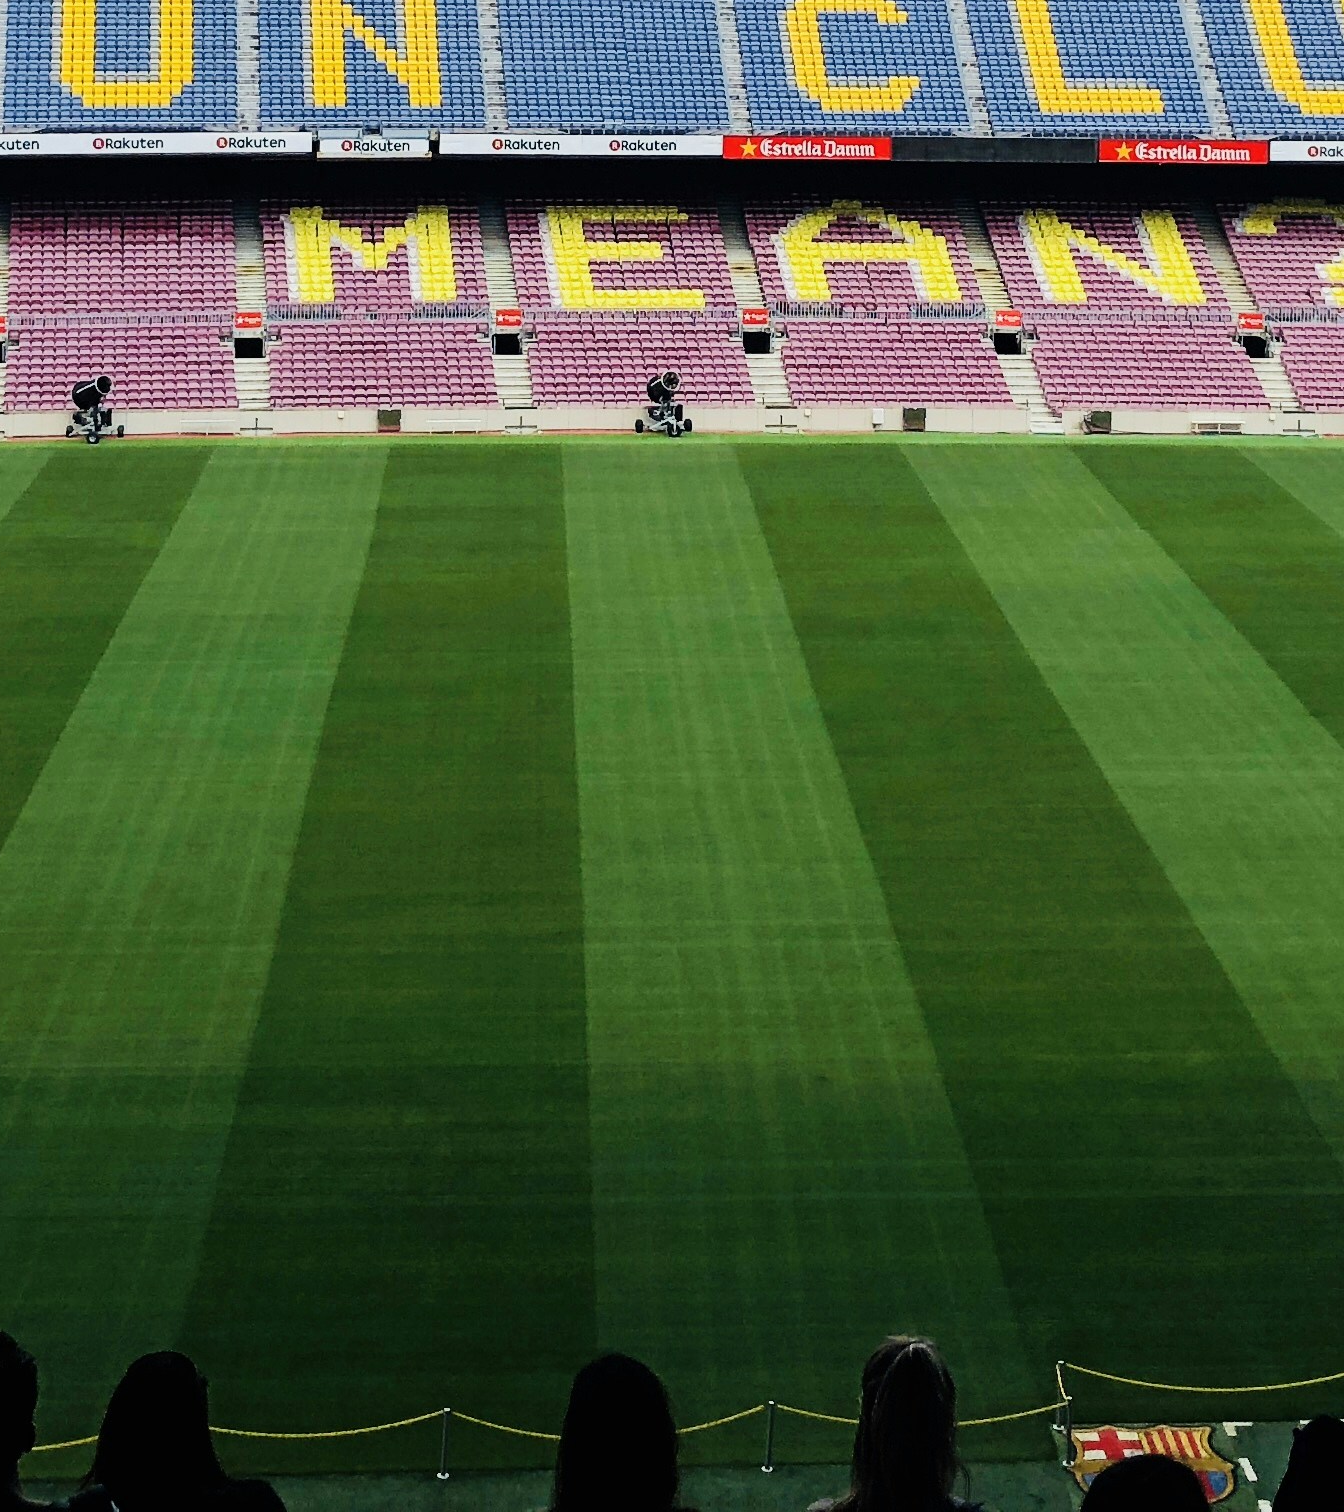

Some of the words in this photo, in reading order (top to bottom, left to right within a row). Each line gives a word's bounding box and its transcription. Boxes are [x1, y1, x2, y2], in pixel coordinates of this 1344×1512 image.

[105, 137, 164, 149] Rakuten
[228, 136, 286, 149] Rakuten
[353, 140, 410, 152] Rakuten
[504, 138, 560, 151] Rakuten
[621, 139, 677, 151] Rakuten
[759, 138, 823, 157] Estrella
[823, 138, 876, 157] Damm
[1134, 142, 1197, 160] Estrella
[1199, 142, 1251, 161] Damm
